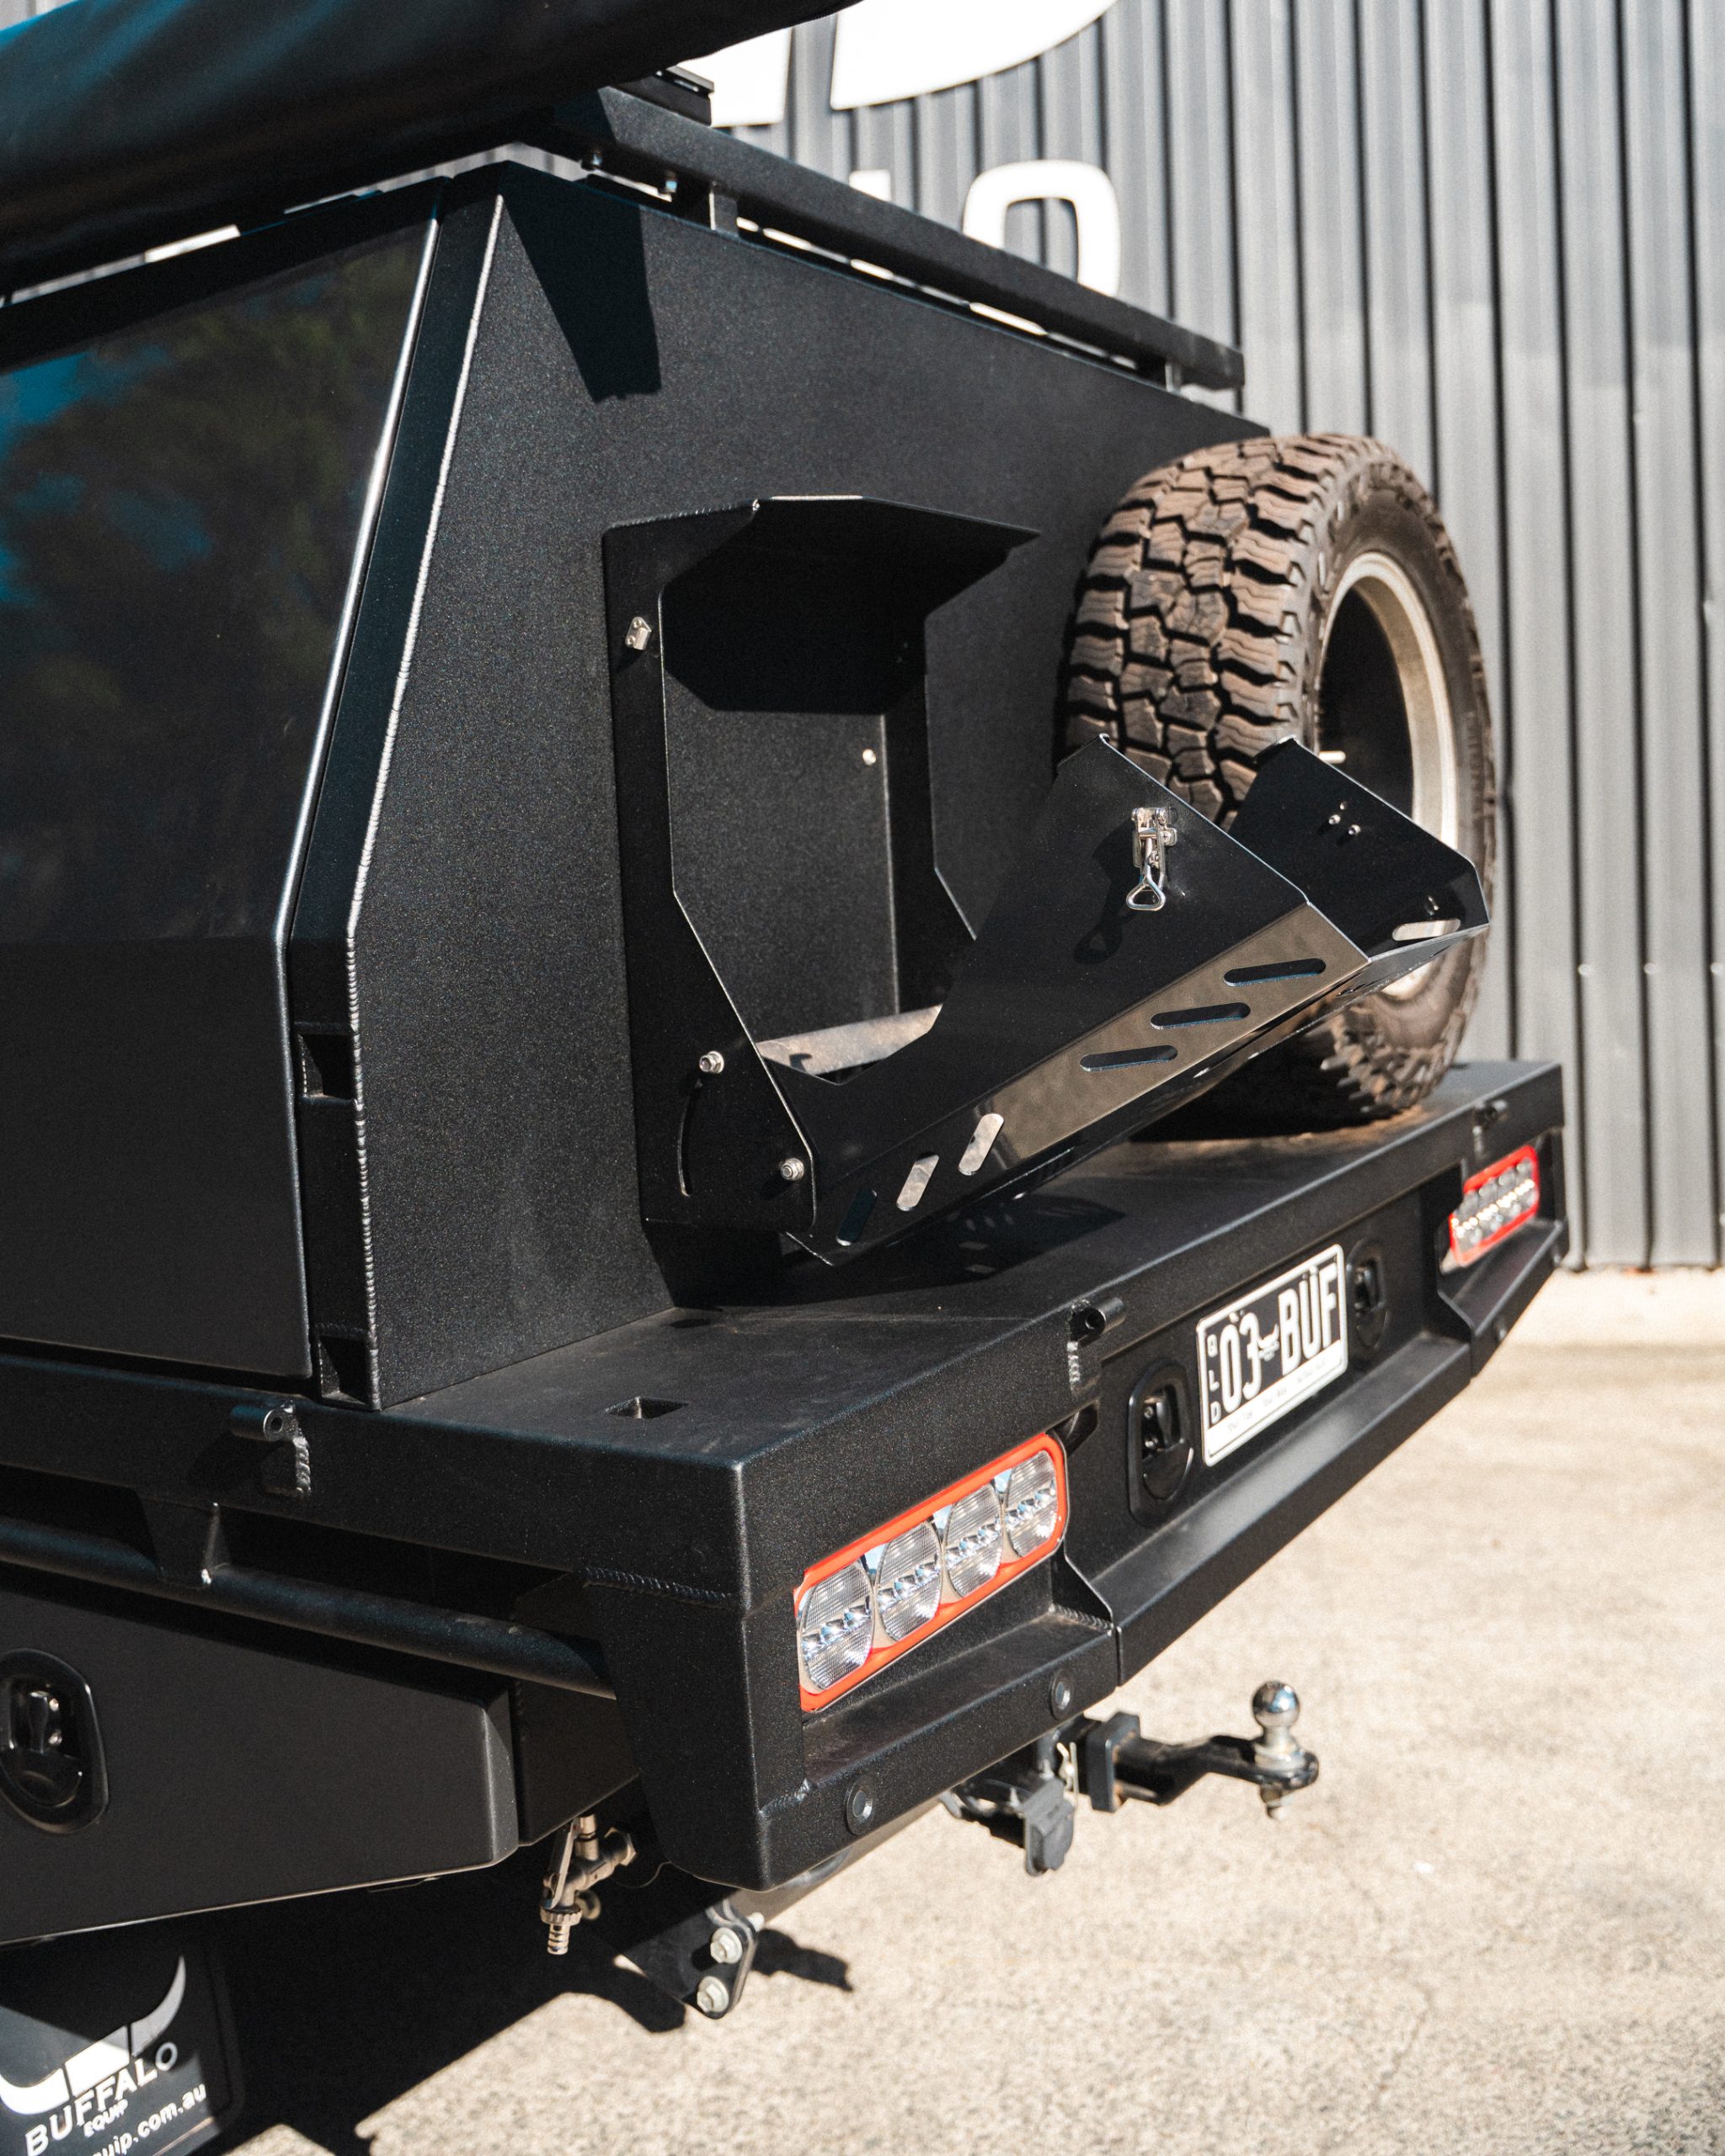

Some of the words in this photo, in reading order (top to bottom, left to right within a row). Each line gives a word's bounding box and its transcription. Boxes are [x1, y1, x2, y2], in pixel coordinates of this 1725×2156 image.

[1220, 1311, 1262, 1413] 03
[1278, 1262, 1338, 1376] BUF
[24, 2041, 179, 2156] BUFFALO
[91, 2083, 207, 2156] uip.com.au
